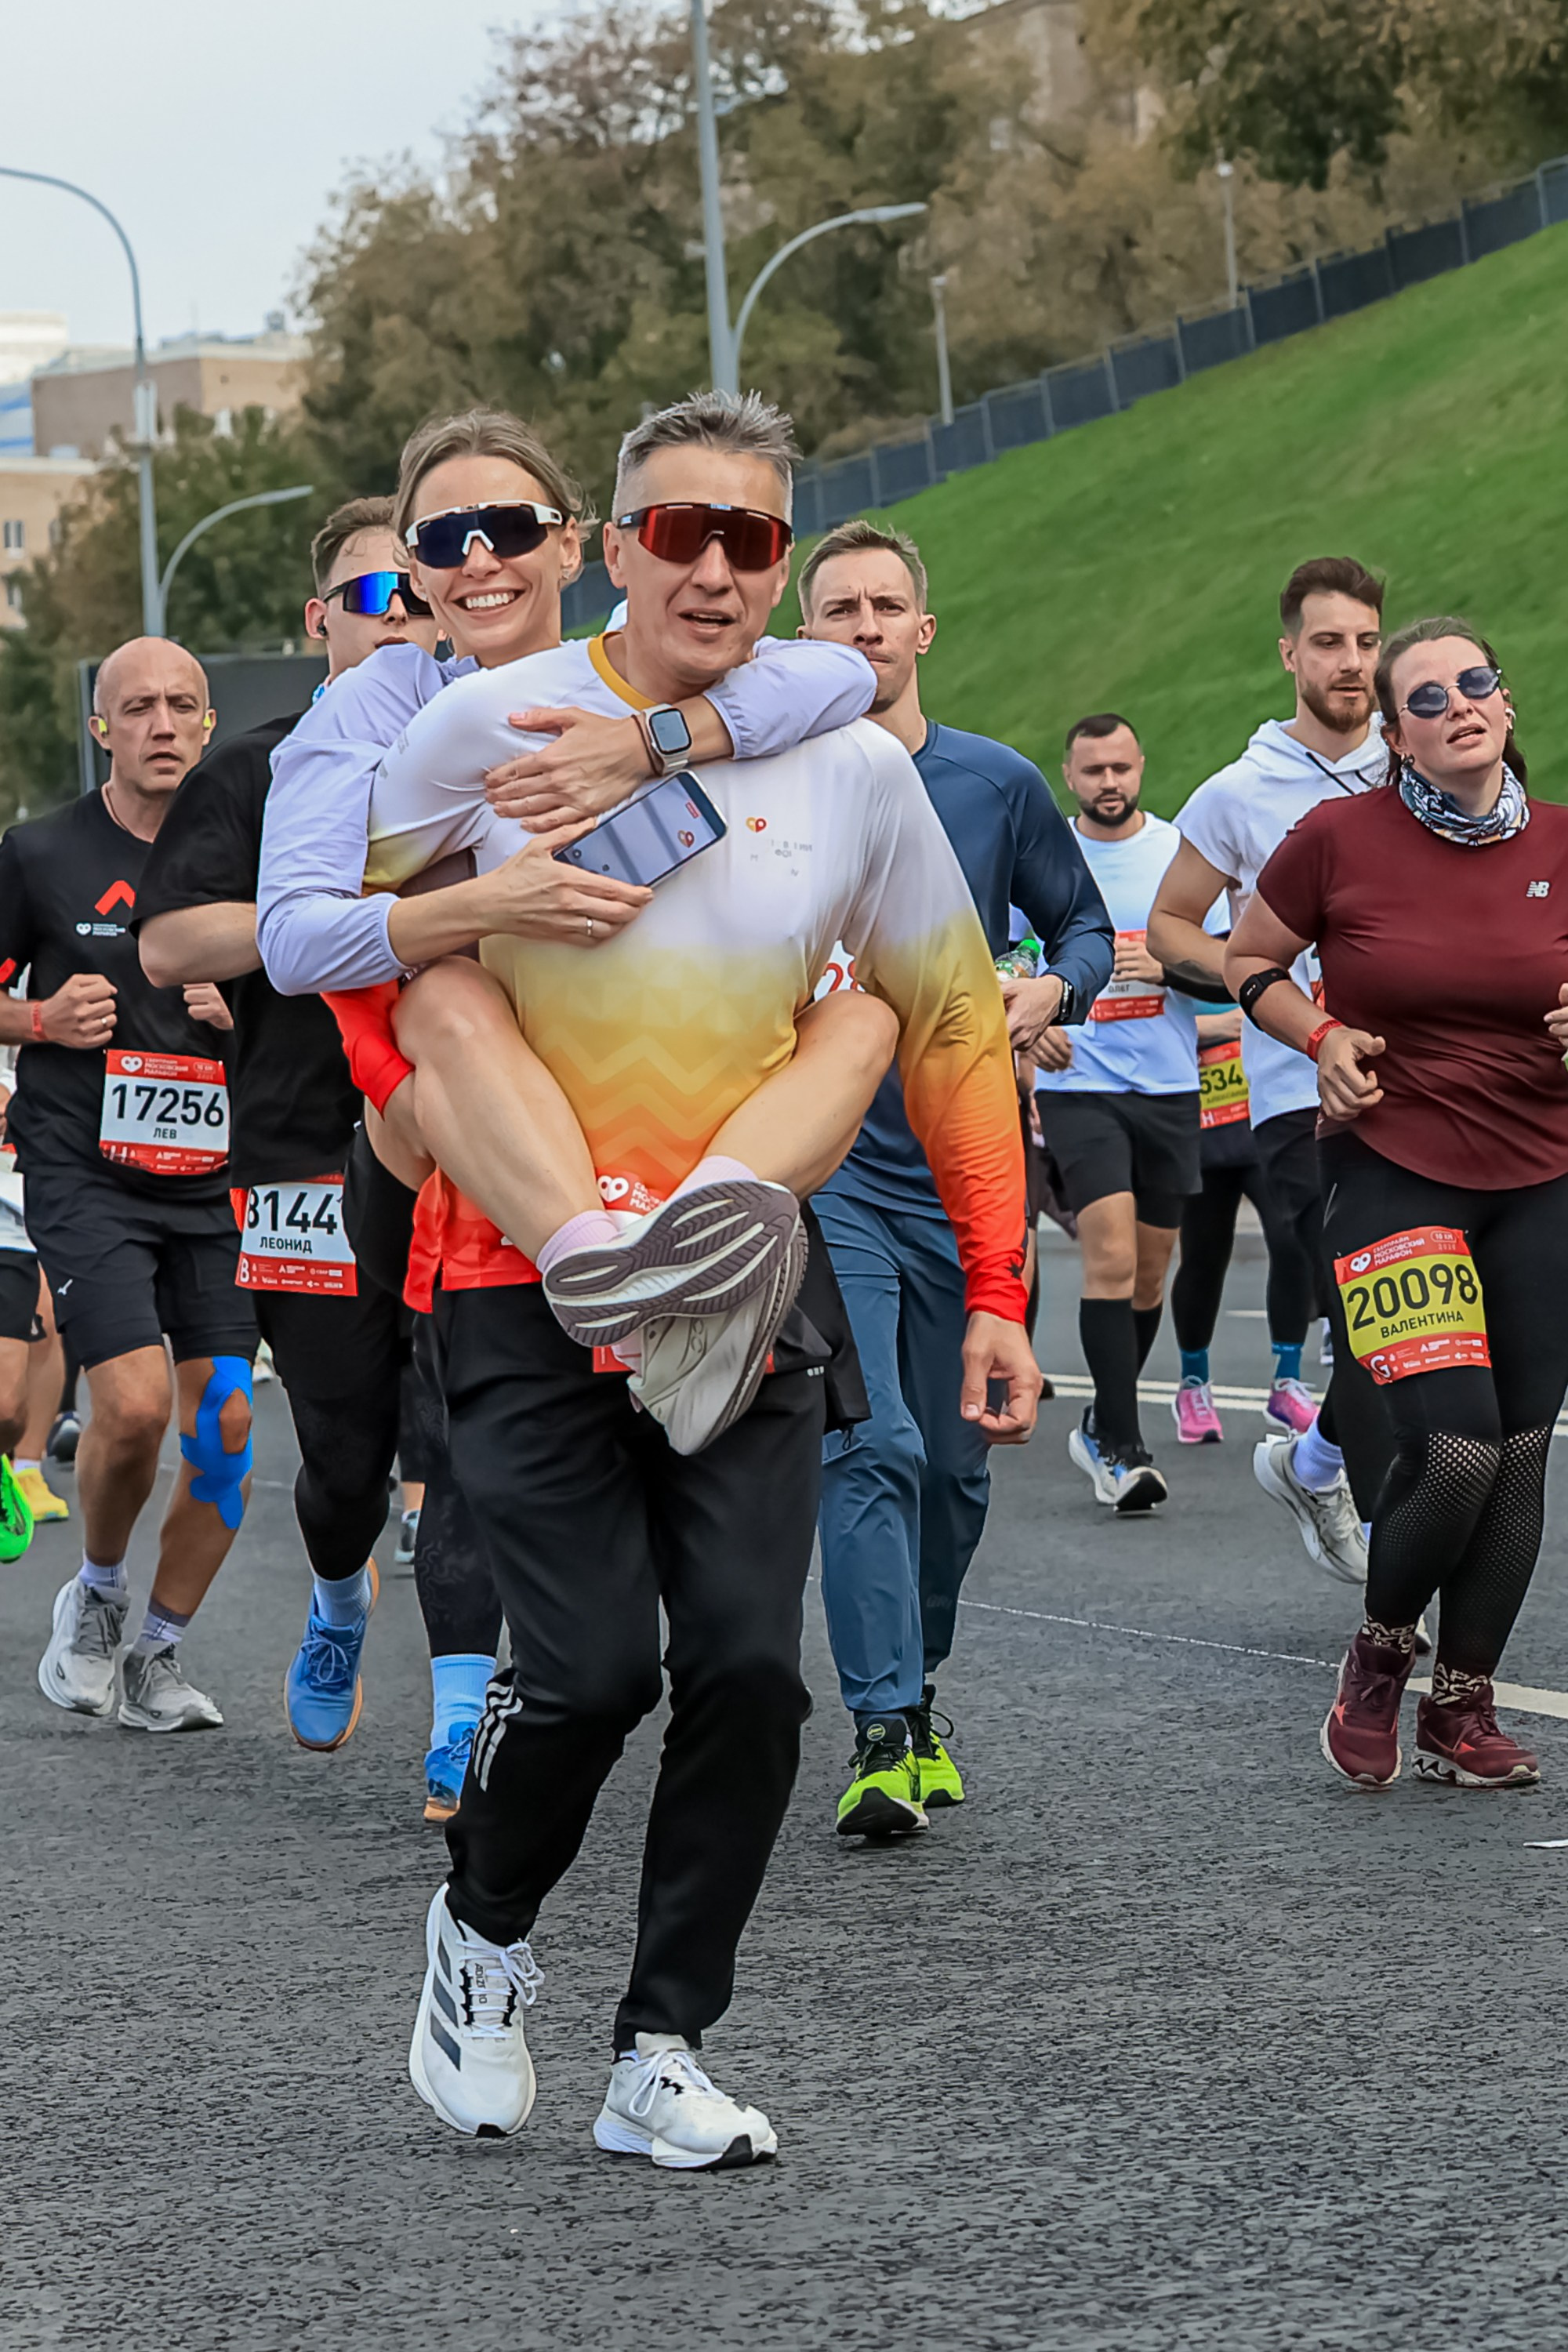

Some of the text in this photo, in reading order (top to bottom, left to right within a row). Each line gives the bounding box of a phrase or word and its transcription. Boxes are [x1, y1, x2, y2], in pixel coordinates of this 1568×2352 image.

[112, 1083, 224, 1127] 17256
[153, 1127, 177, 1139] ЛЕВ
[260, 1236, 313, 1254] ЛЕОНИД
[1374, 1238, 1425, 1258] МОСКОВСКИЙ
[1374, 1250, 1413, 1266] МАРАФОН
[1347, 1264, 1478, 1331] 20098
[1381, 1311, 1465, 1338] ВАЛЕНТИНА
[1370, 1355, 1391, 1377] G
[475, 1962, 488, 2004] ADIZO
